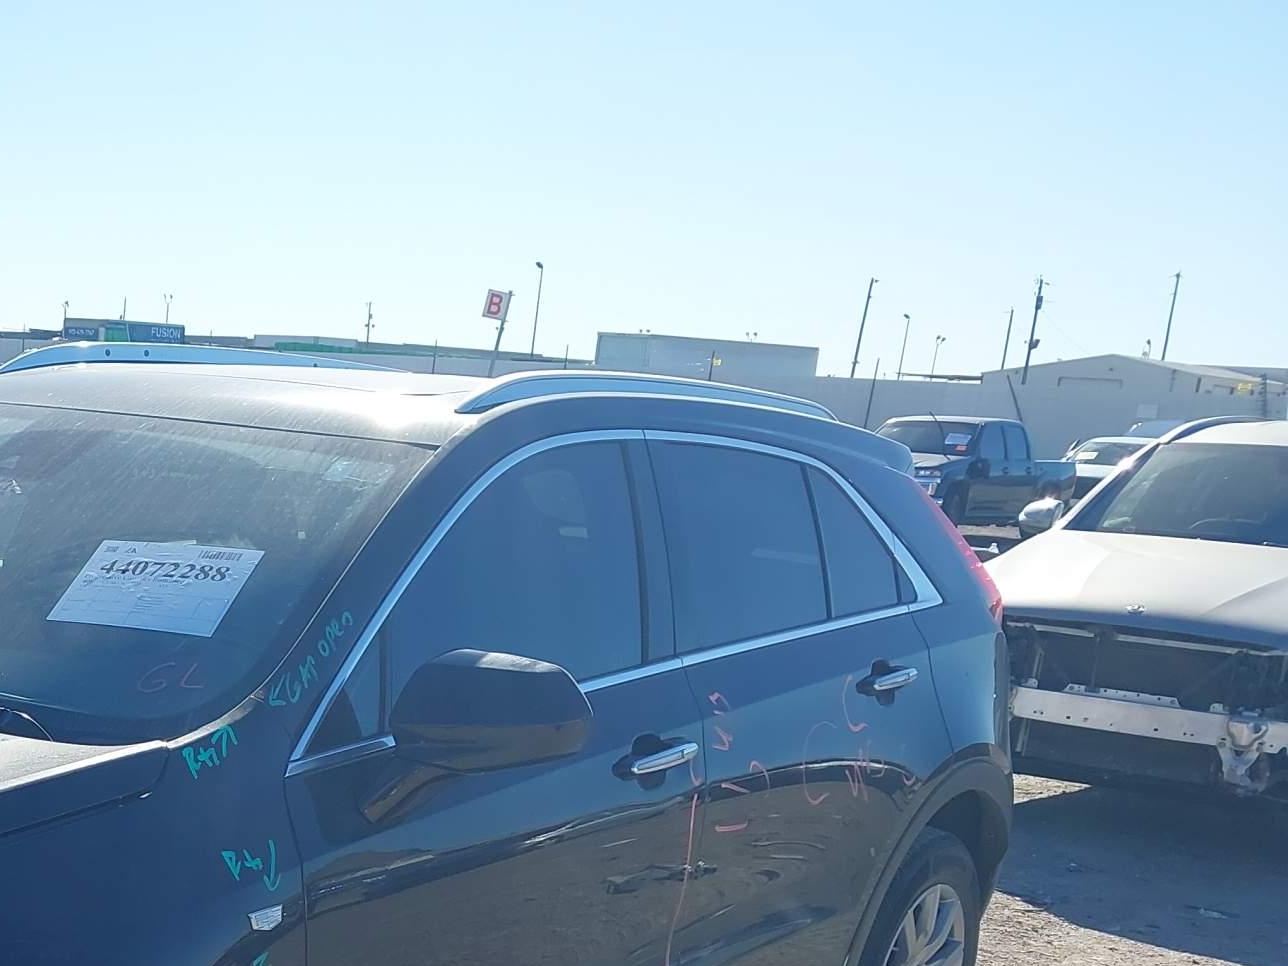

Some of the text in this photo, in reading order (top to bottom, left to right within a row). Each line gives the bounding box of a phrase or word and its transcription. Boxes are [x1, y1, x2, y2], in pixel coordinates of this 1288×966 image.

[487, 292, 504, 316] B
[151, 327, 181, 340] FUSION
[99, 559, 231, 582] 44072288
